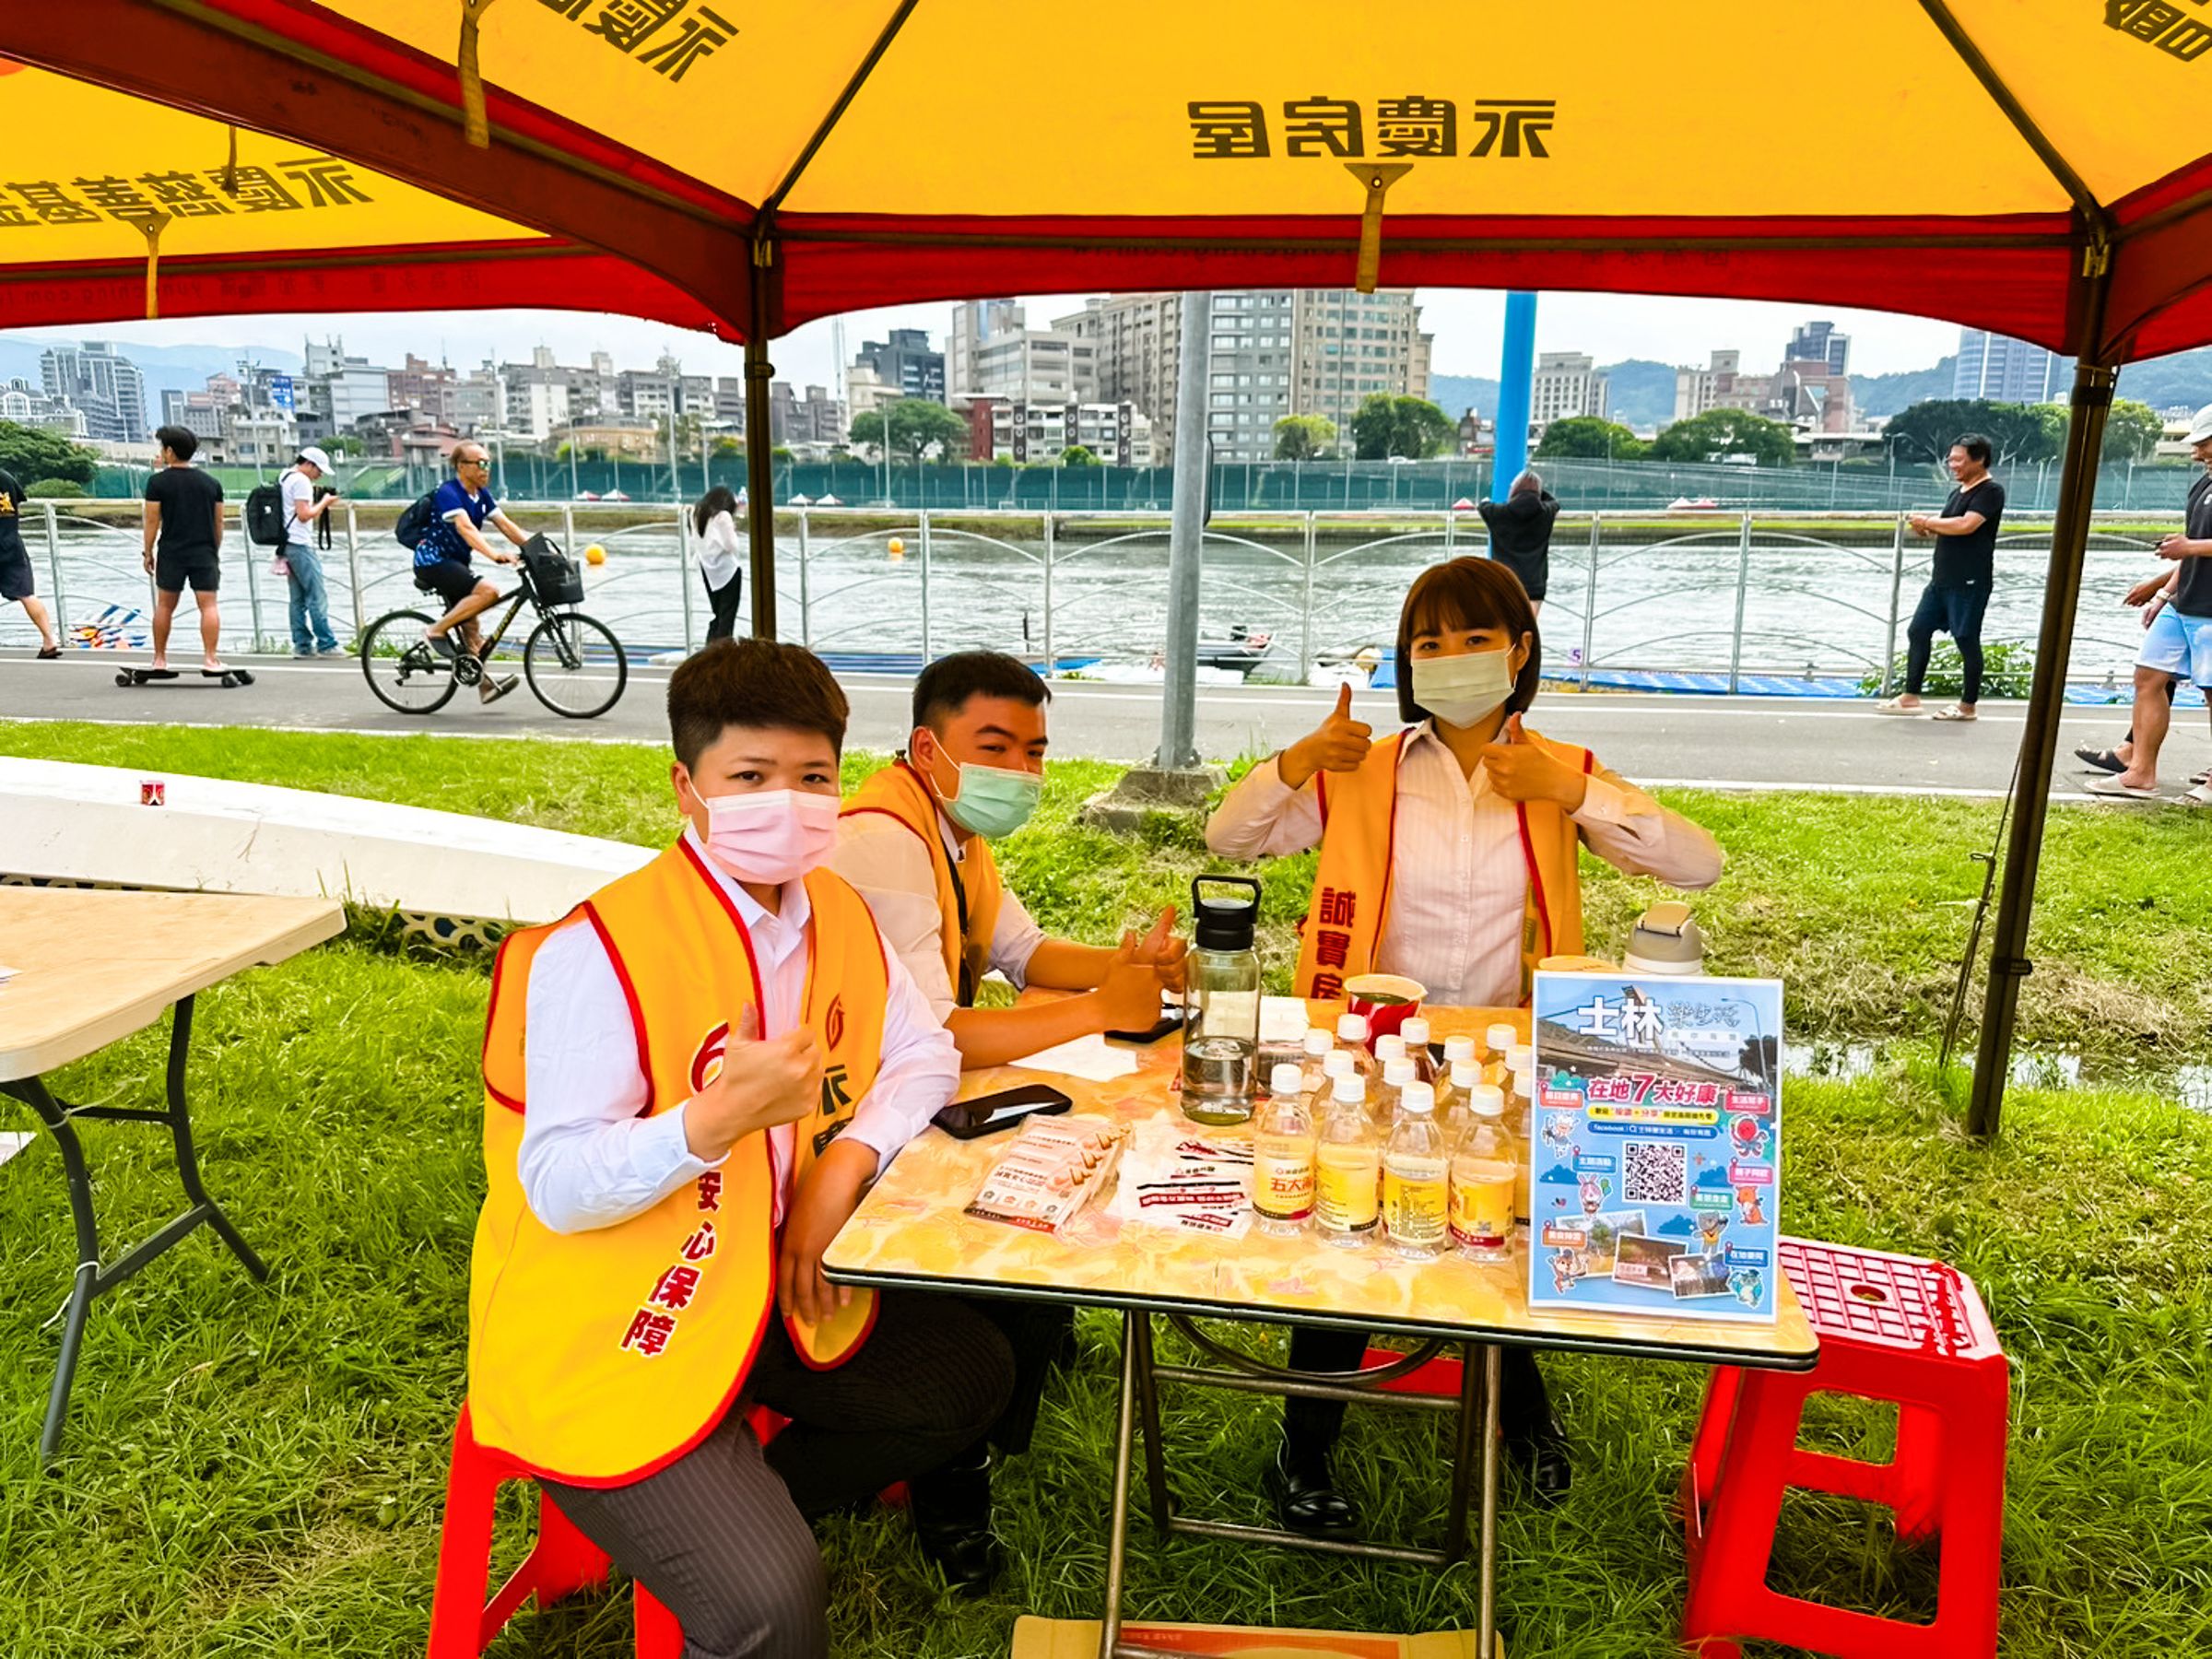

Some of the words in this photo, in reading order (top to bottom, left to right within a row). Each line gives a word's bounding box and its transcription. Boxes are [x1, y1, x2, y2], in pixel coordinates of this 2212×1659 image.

[1577, 996, 1664, 1041] 士林
[1588, 1073, 1719, 1104] 在地7大好康
[621, 1171, 722, 1356] 安心保障
